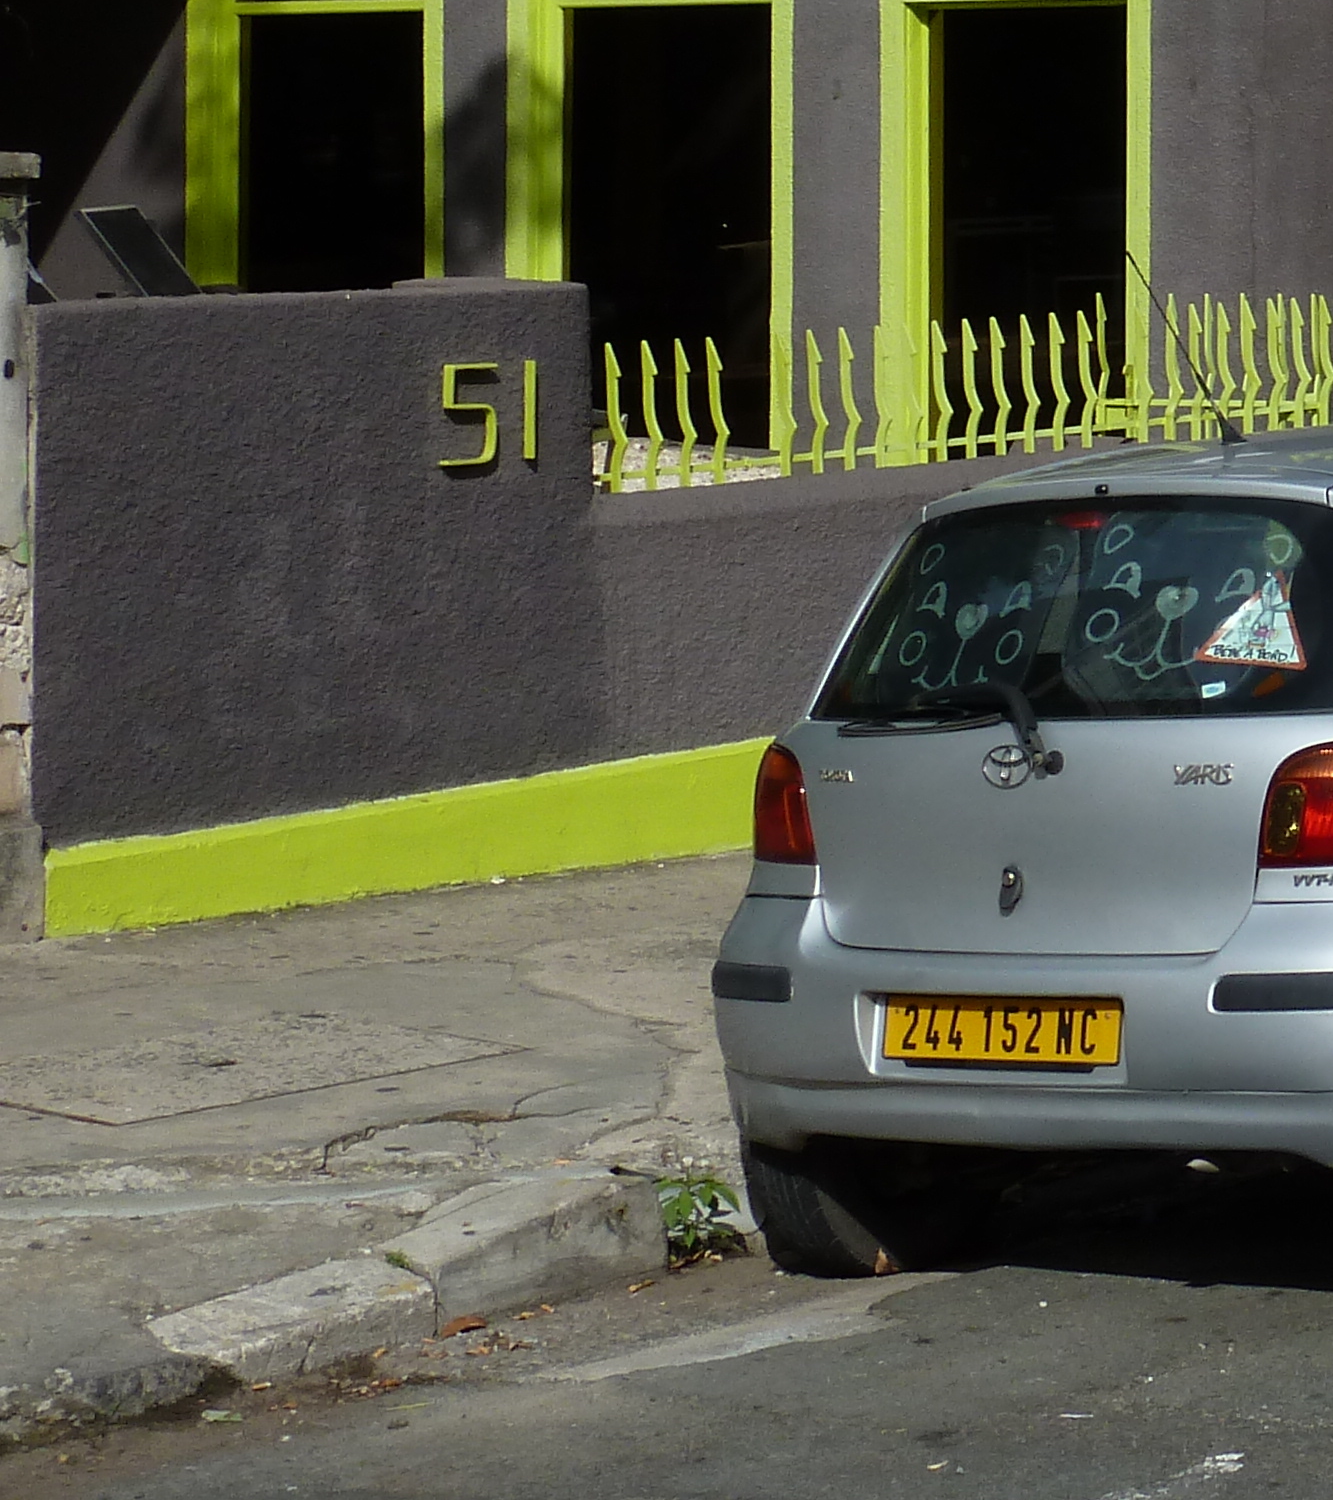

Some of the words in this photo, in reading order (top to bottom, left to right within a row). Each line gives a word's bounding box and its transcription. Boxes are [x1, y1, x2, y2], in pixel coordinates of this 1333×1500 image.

[438, 360, 537, 466] 51
[1173, 763, 1235, 786] YARIS
[901, 1004, 963, 1051] 244
[983, 1005, 1043, 1054] 152
[1055, 1007, 1098, 1056] NC
